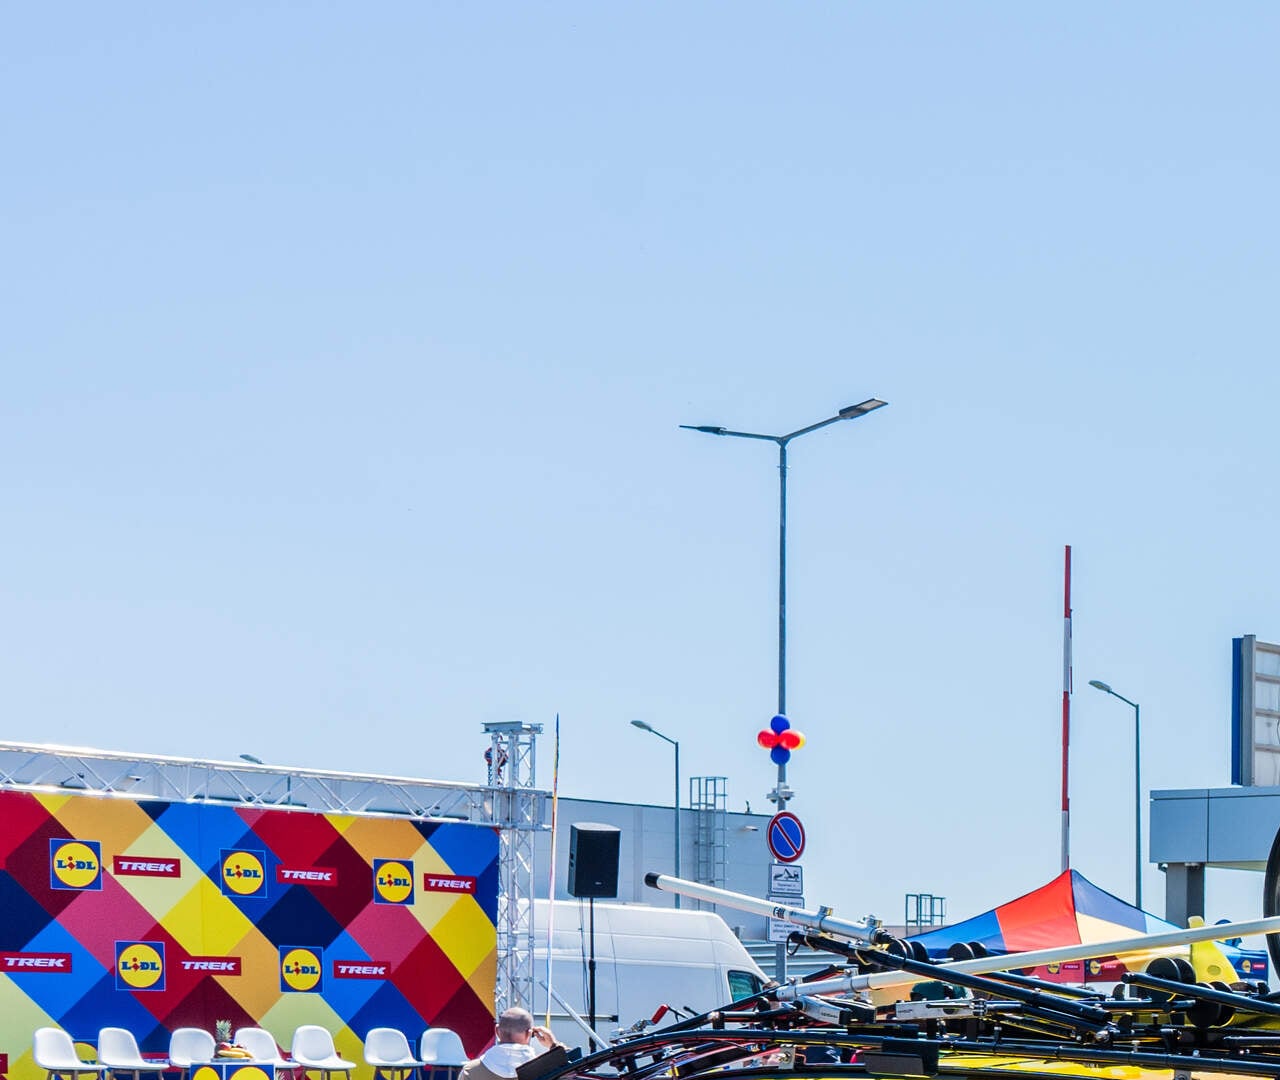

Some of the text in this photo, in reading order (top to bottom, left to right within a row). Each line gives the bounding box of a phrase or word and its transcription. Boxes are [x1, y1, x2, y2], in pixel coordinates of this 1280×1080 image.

[118, 861, 175, 873] TREK
[281, 869, 332, 881] TREK
[427, 878, 471, 890] TREK
[4, 957, 65, 968] TREK
[181, 960, 236, 971] TREK
[338, 965, 386, 976] TREK
